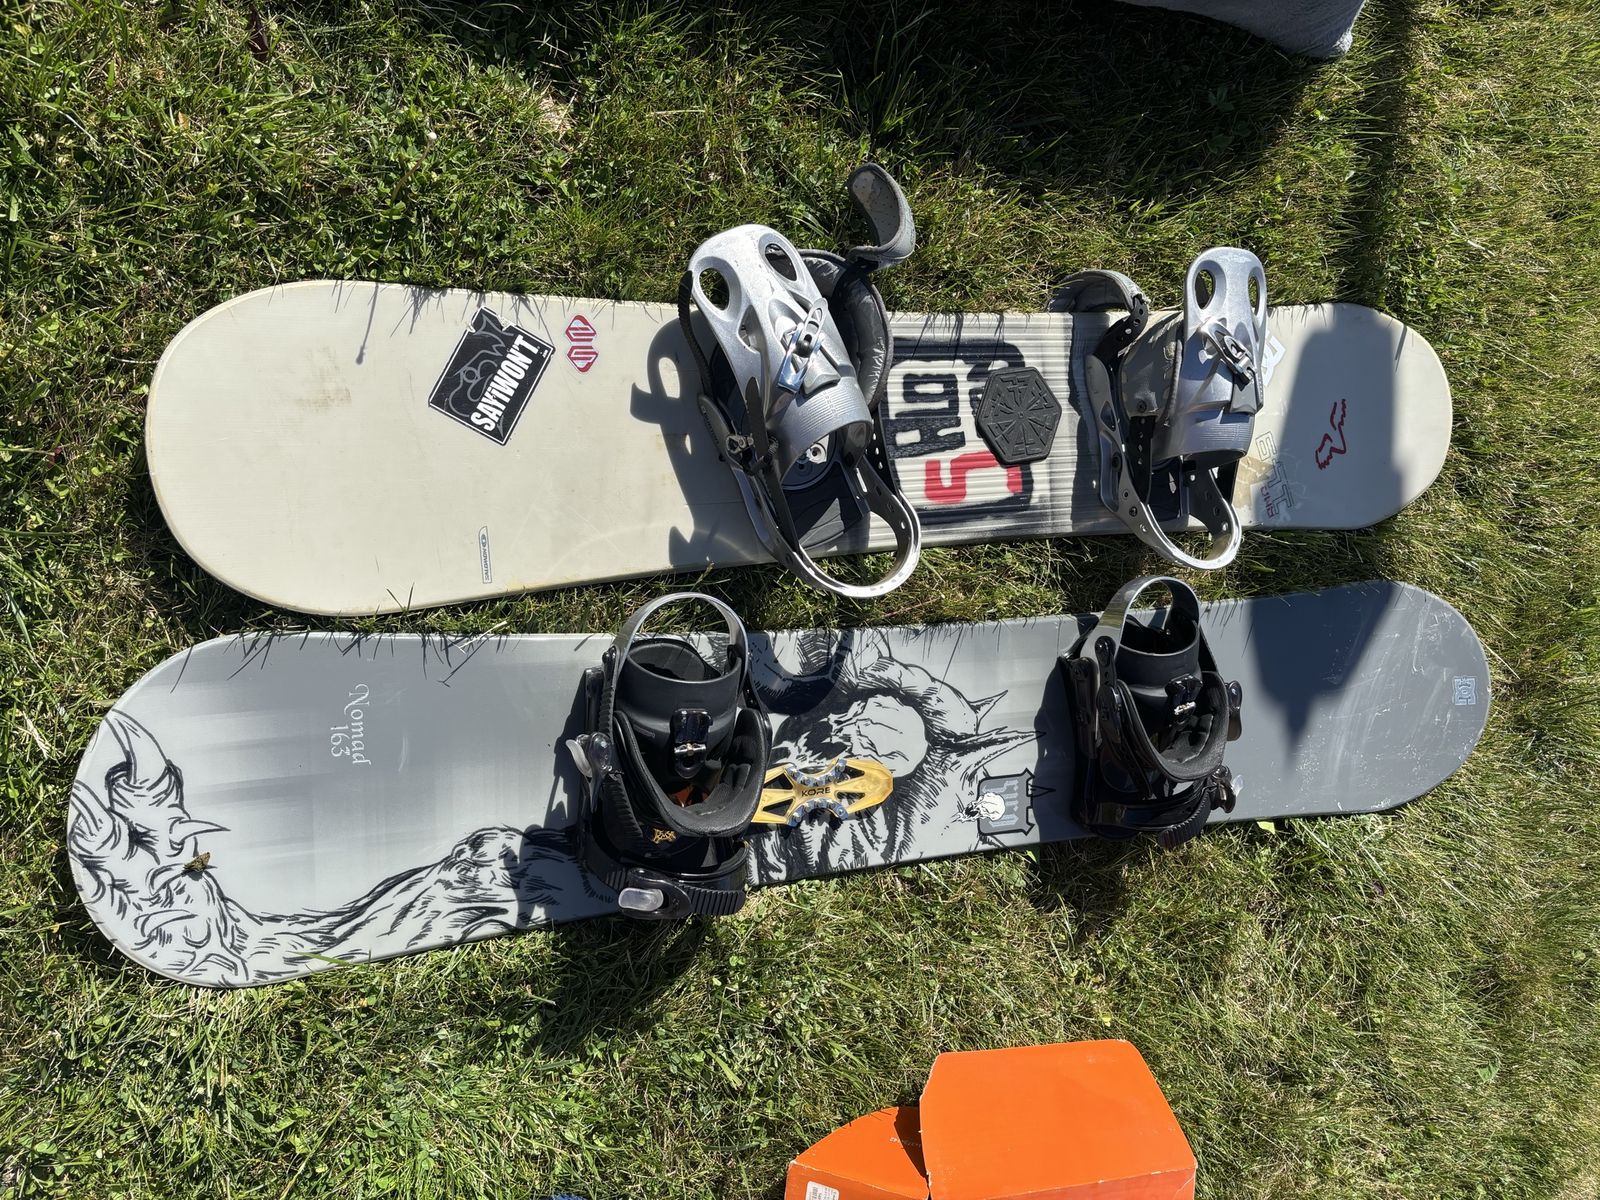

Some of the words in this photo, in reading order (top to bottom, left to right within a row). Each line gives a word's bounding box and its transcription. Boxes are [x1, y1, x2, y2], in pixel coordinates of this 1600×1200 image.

[482, 547, 490, 581] SALOMON
[330, 724, 350, 757] 163
[343, 683, 372, 765] Nomad
[801, 786, 831, 797] KORE
